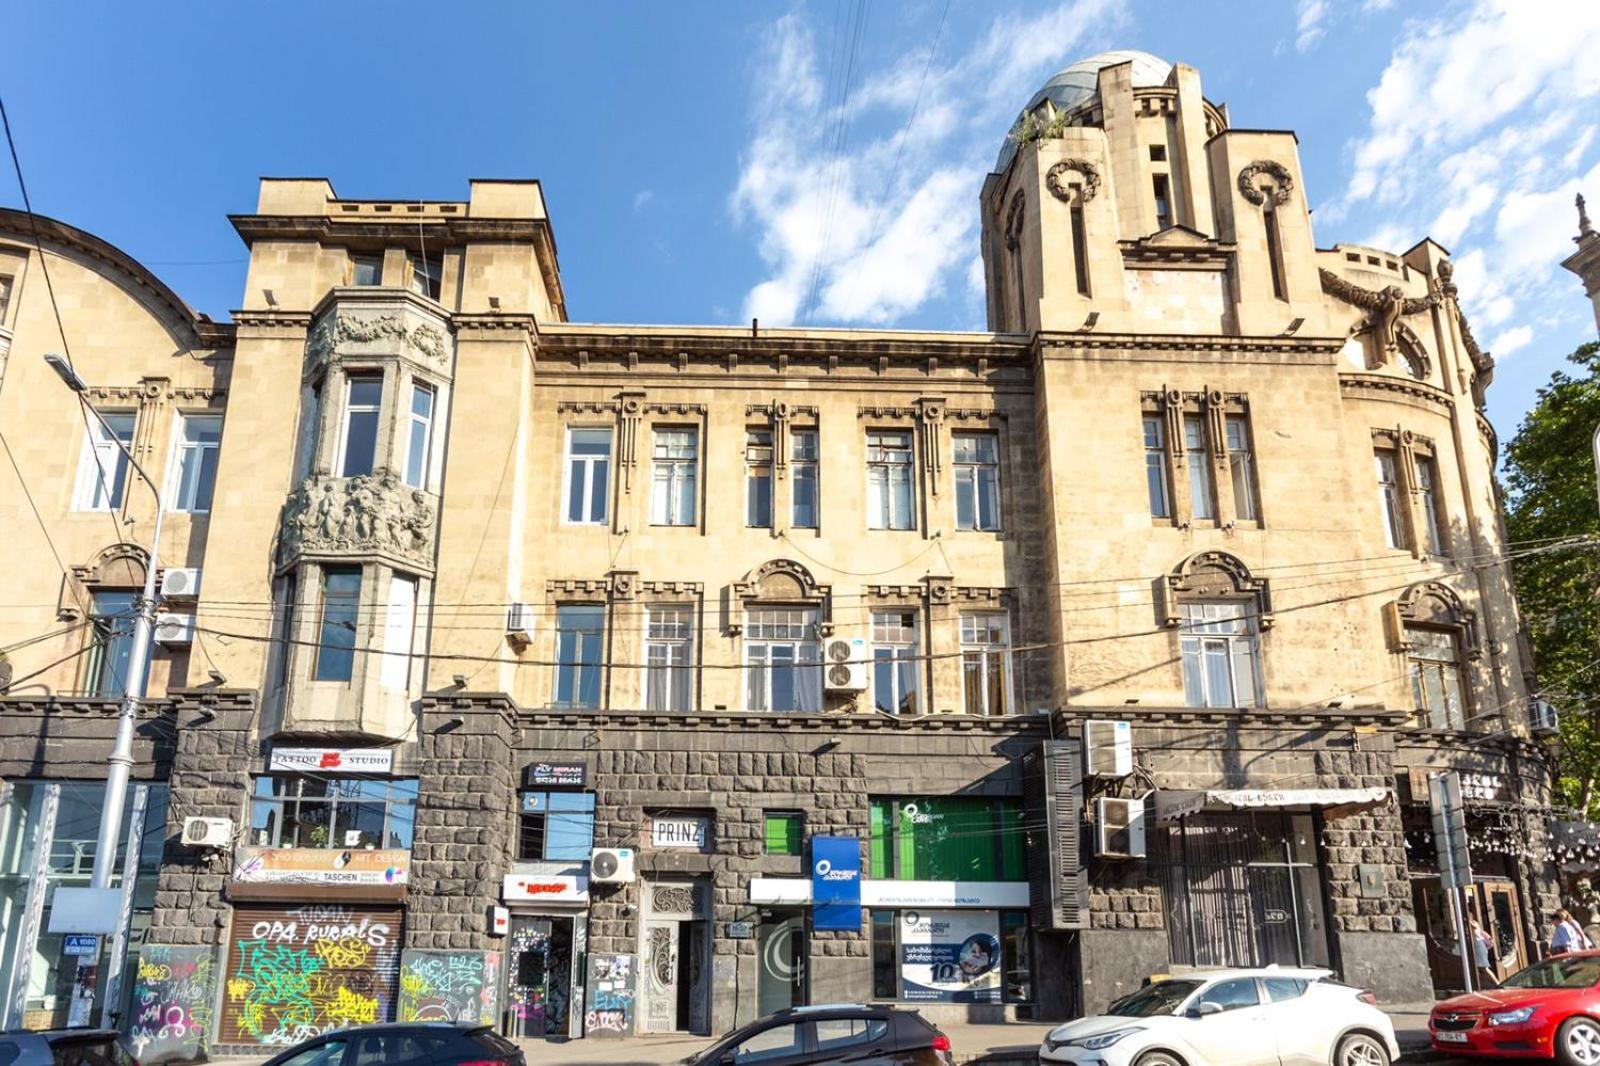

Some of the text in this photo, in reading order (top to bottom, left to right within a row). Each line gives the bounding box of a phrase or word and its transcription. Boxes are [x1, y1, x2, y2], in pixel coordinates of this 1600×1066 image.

[274, 755, 317, 764] TATTOO
[349, 757, 388, 765] STUDIO
[658, 823, 700, 842] PRINZ
[355, 854, 371, 862] ART
[324, 873, 358, 882] TASCHEN
[70, 938, 78, 946] A
[930, 963, 954, 982] 10
